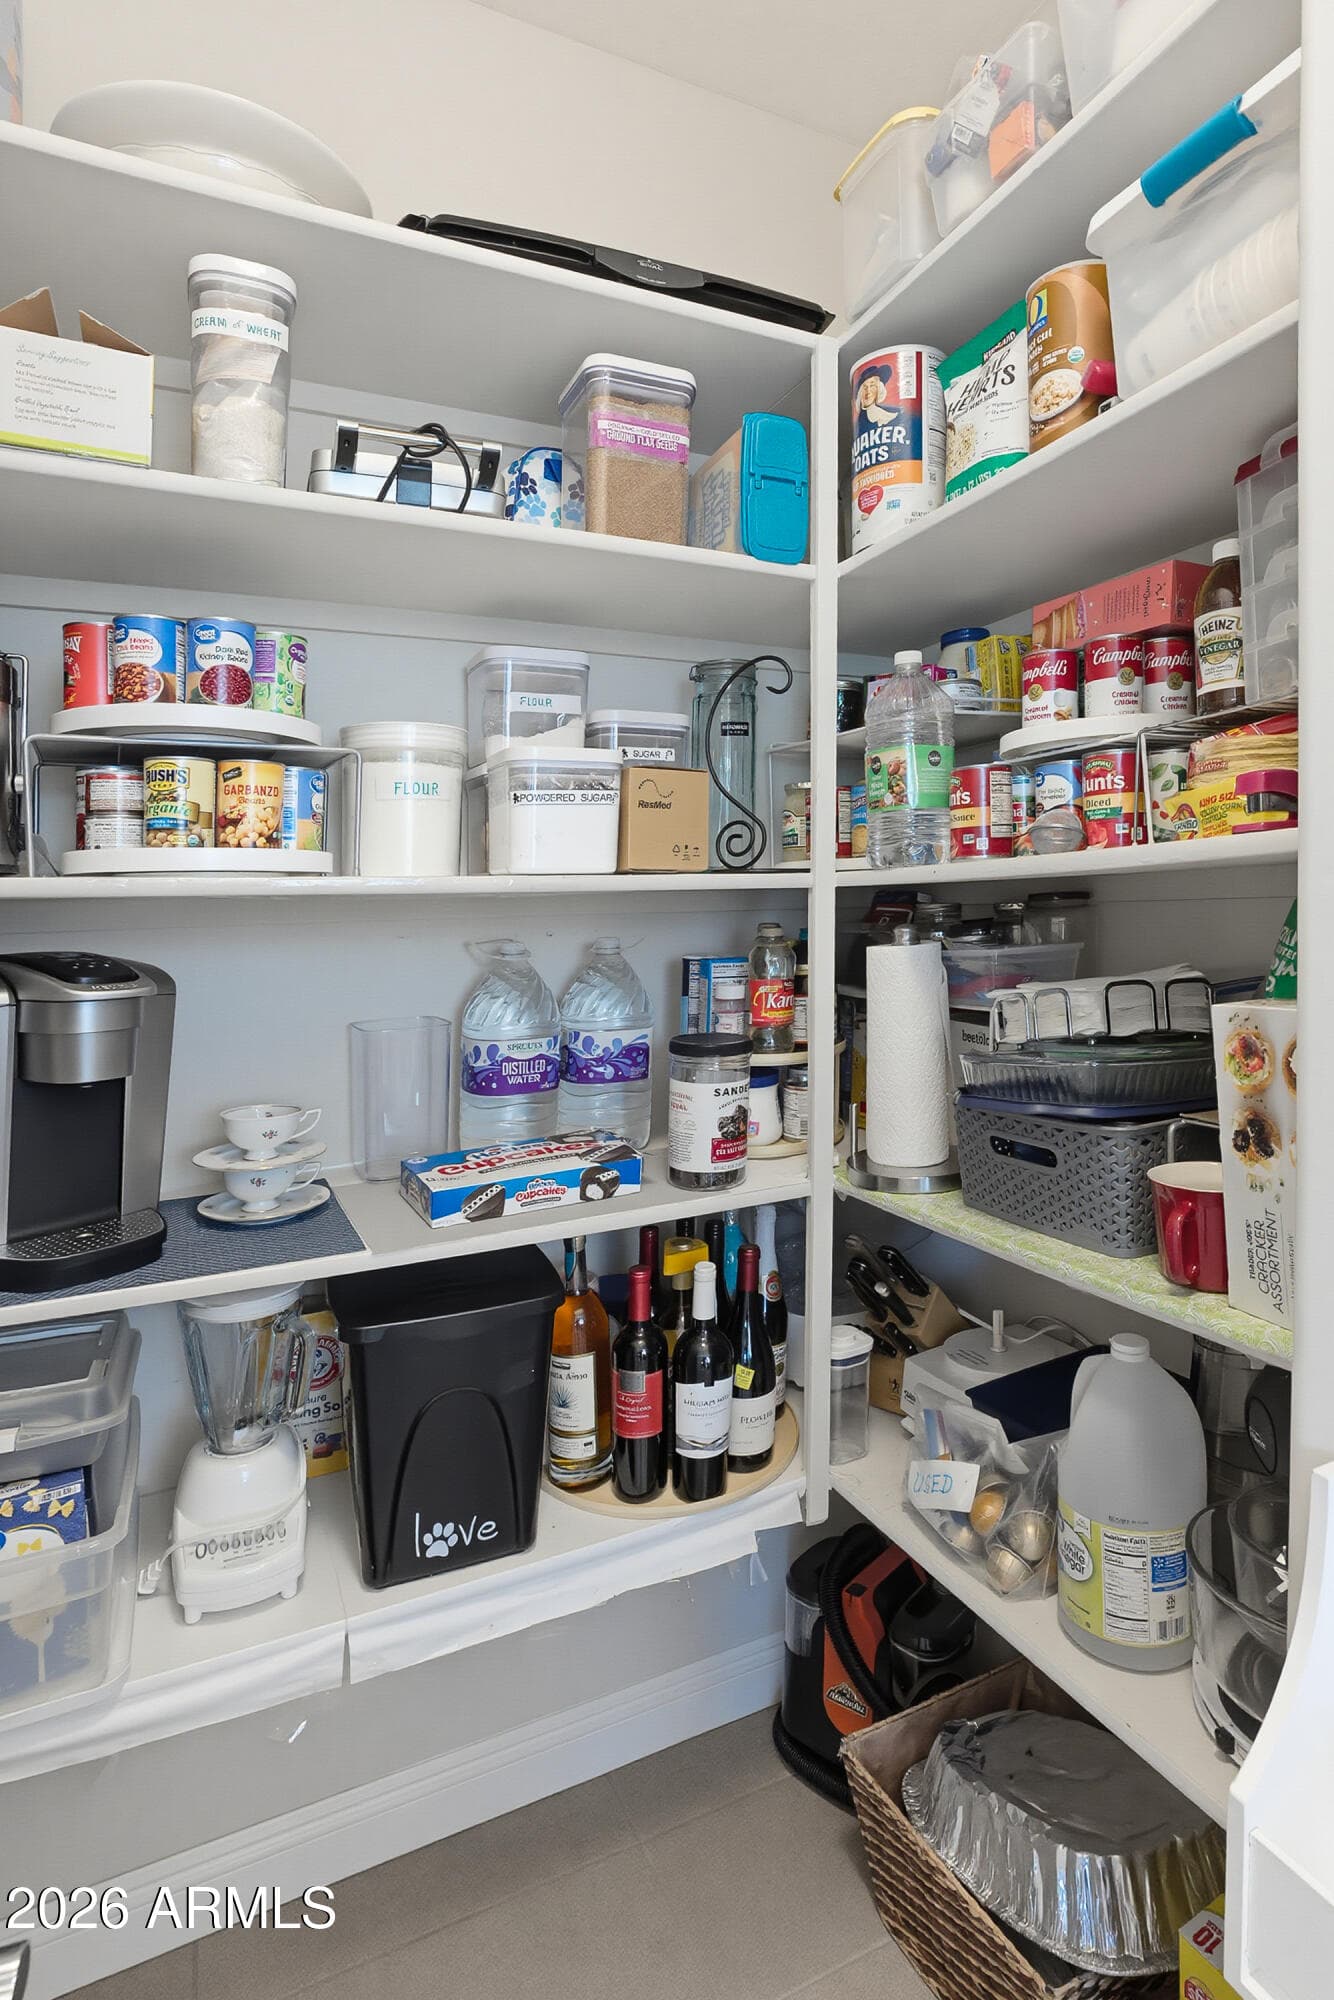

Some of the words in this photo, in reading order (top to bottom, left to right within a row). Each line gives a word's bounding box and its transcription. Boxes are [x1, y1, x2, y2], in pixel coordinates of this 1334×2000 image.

[193, 316, 228, 330] CREAM
[246, 324, 283, 341] WHEAT
[606, 429, 636, 444] GROUND
[637, 435, 655, 448] FLAX
[656, 439, 678, 452] SEEDS
[855, 445, 889, 472] OATS
[1201, 619, 1236, 635] HEINZ
[215, 645, 234, 653] Dark
[1200, 640, 1240, 656] VINEGAR
[199, 652, 225, 661] Kidney
[519, 696, 552, 708] FLOUR
[632, 750, 661, 759] SUGAR
[145, 769, 187, 785] BUSH'S
[223, 784, 280, 797] GARBANZO
[394, 781, 440, 795] FLOUR
[950, 787, 971, 805] nt's
[519, 793, 576, 803] POWDERED
[580, 793, 613, 803] SUGAR
[1199, 795, 1218, 808] KING
[1218, 791, 1236, 802] SIZ
[507, 1042, 543, 1051] SPROUTS
[502, 1059, 546, 1076] DISTILLED
[507, 1075, 541, 1085] WATER
[713, 1084, 749, 1097] SANDE
[515, 1186, 567, 1201] Cupcakes
[1253, 1219, 1270, 1295] CRACKER
[1264, 1207, 1285, 1314] ASSORTMENT
[912, 1471, 953, 1494] USED
[1192, 1926, 1222, 1954] 10
